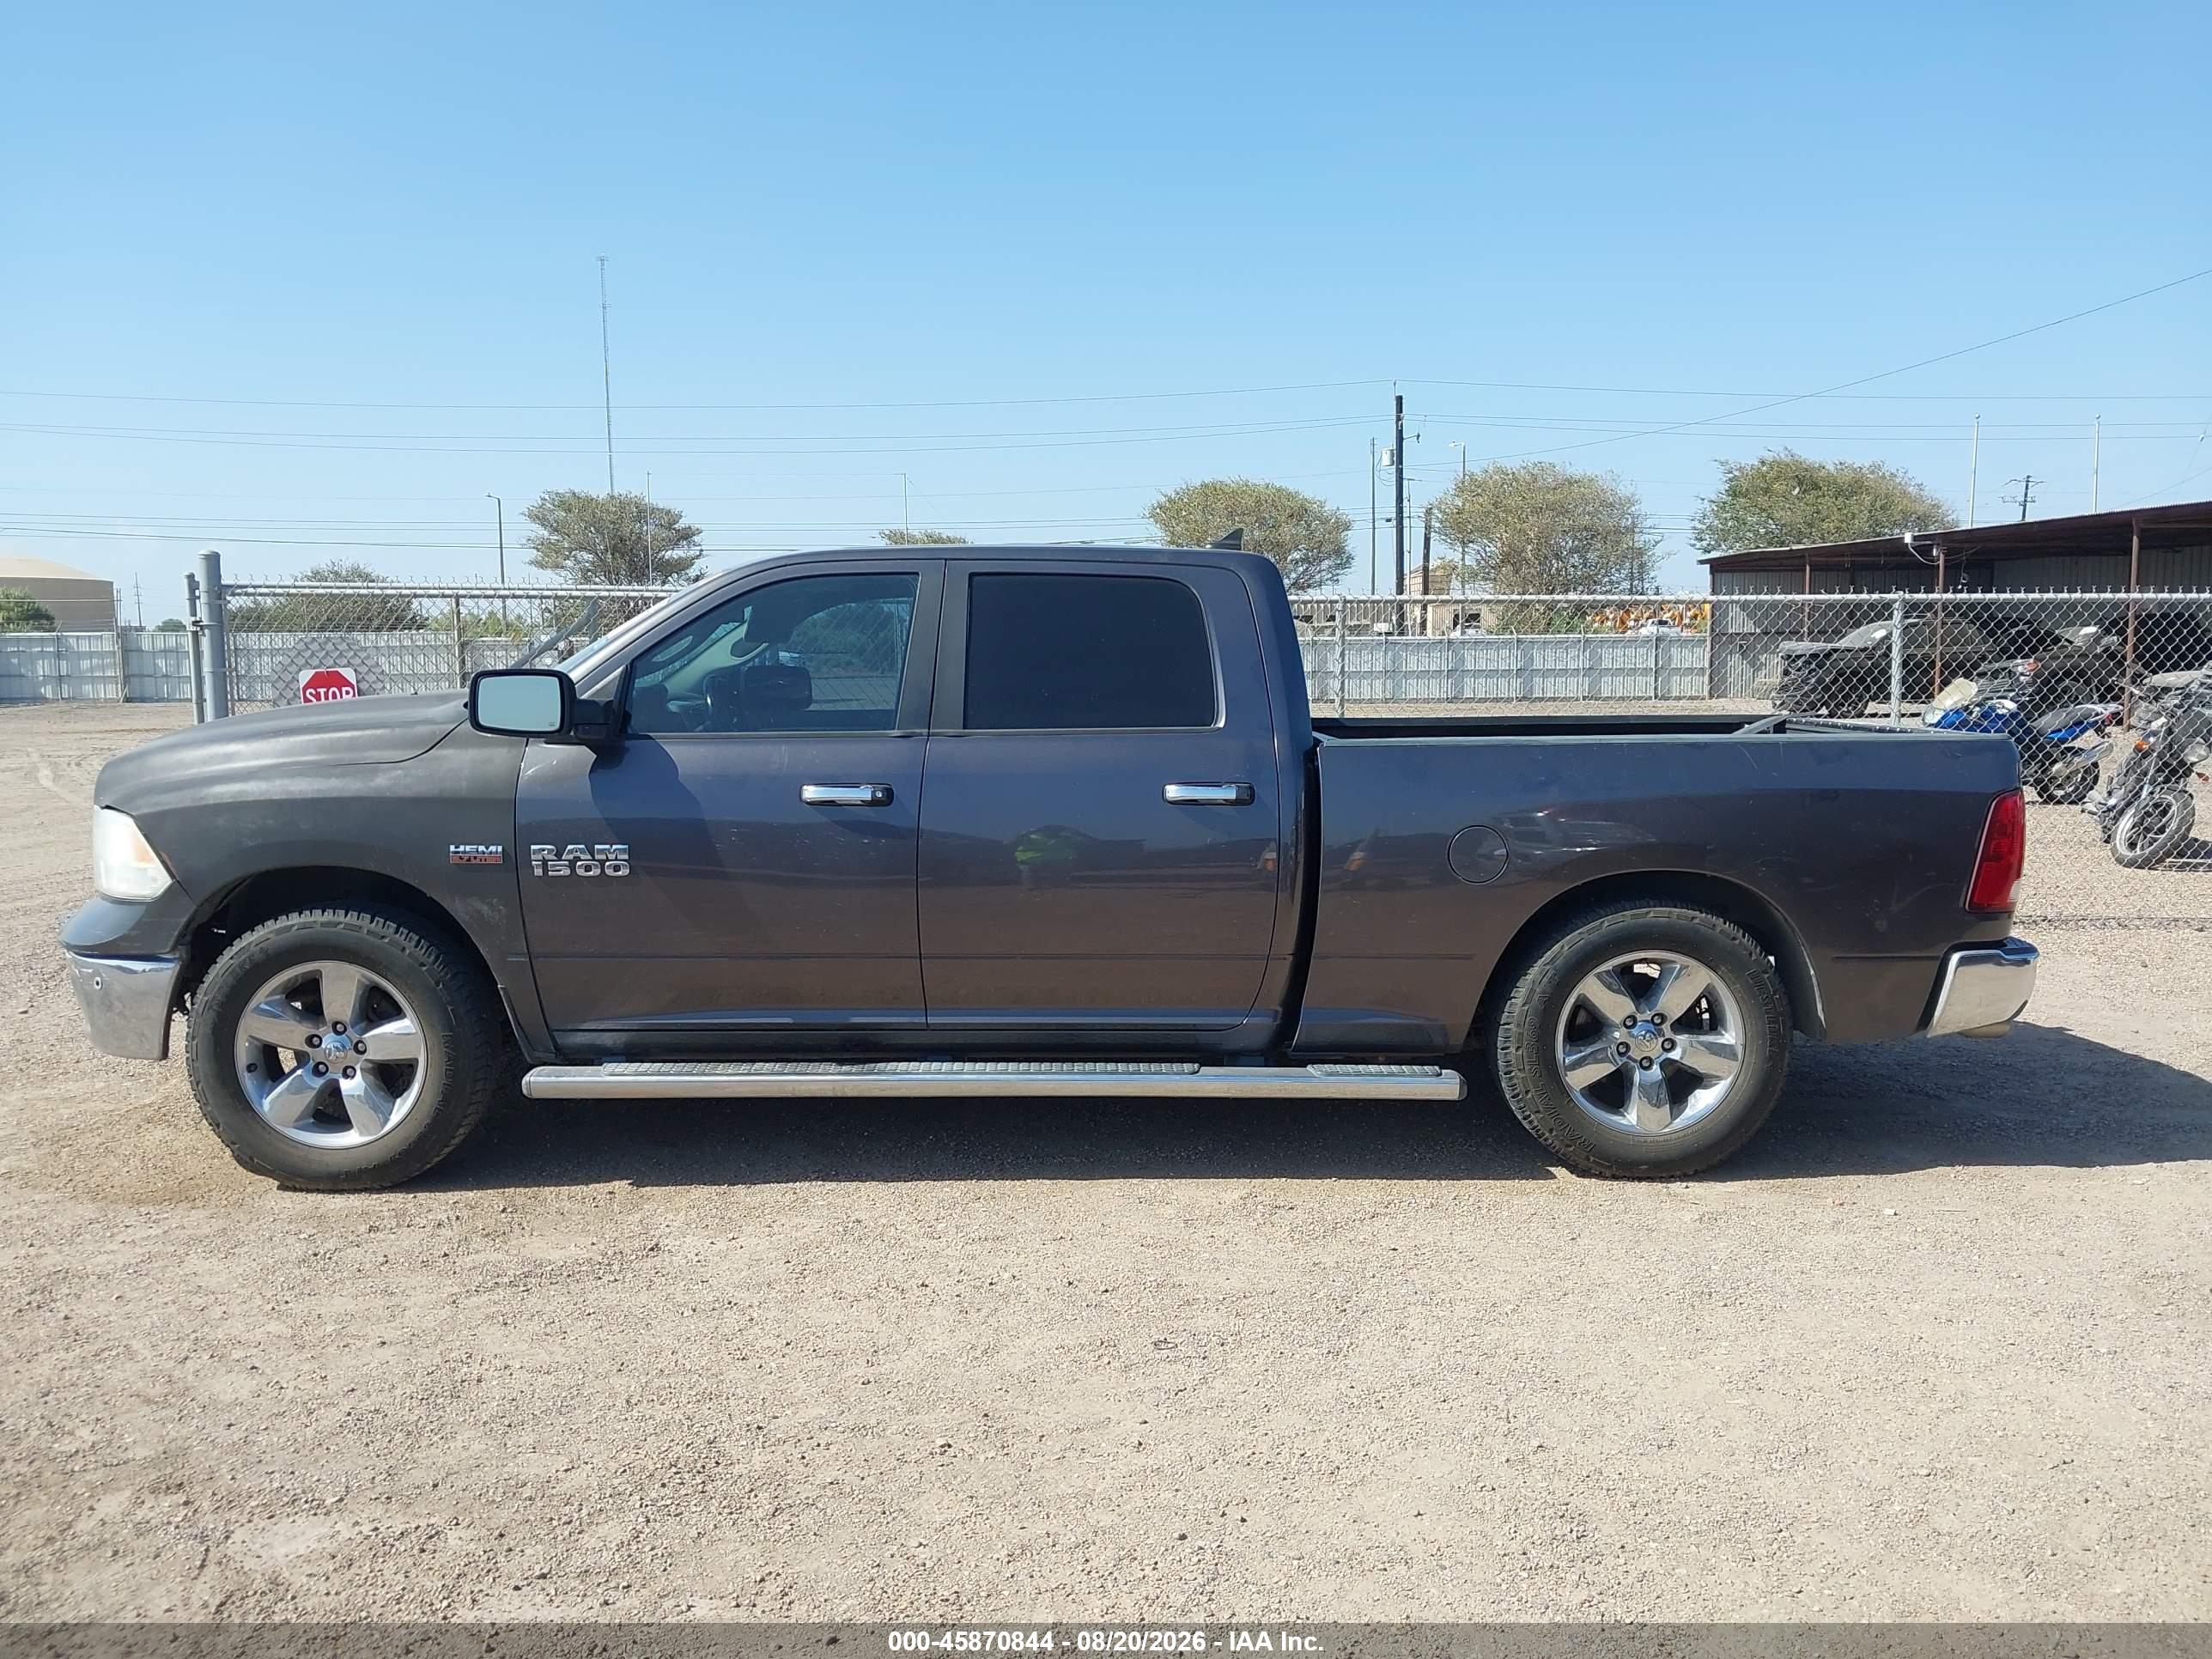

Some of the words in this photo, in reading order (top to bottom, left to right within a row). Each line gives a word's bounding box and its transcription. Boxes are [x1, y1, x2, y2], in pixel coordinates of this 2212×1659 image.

[305, 687, 354, 702] STOP
[449, 844, 503, 854] HEMI
[530, 844, 629, 860] RAM
[532, 860, 630, 877] 1500
